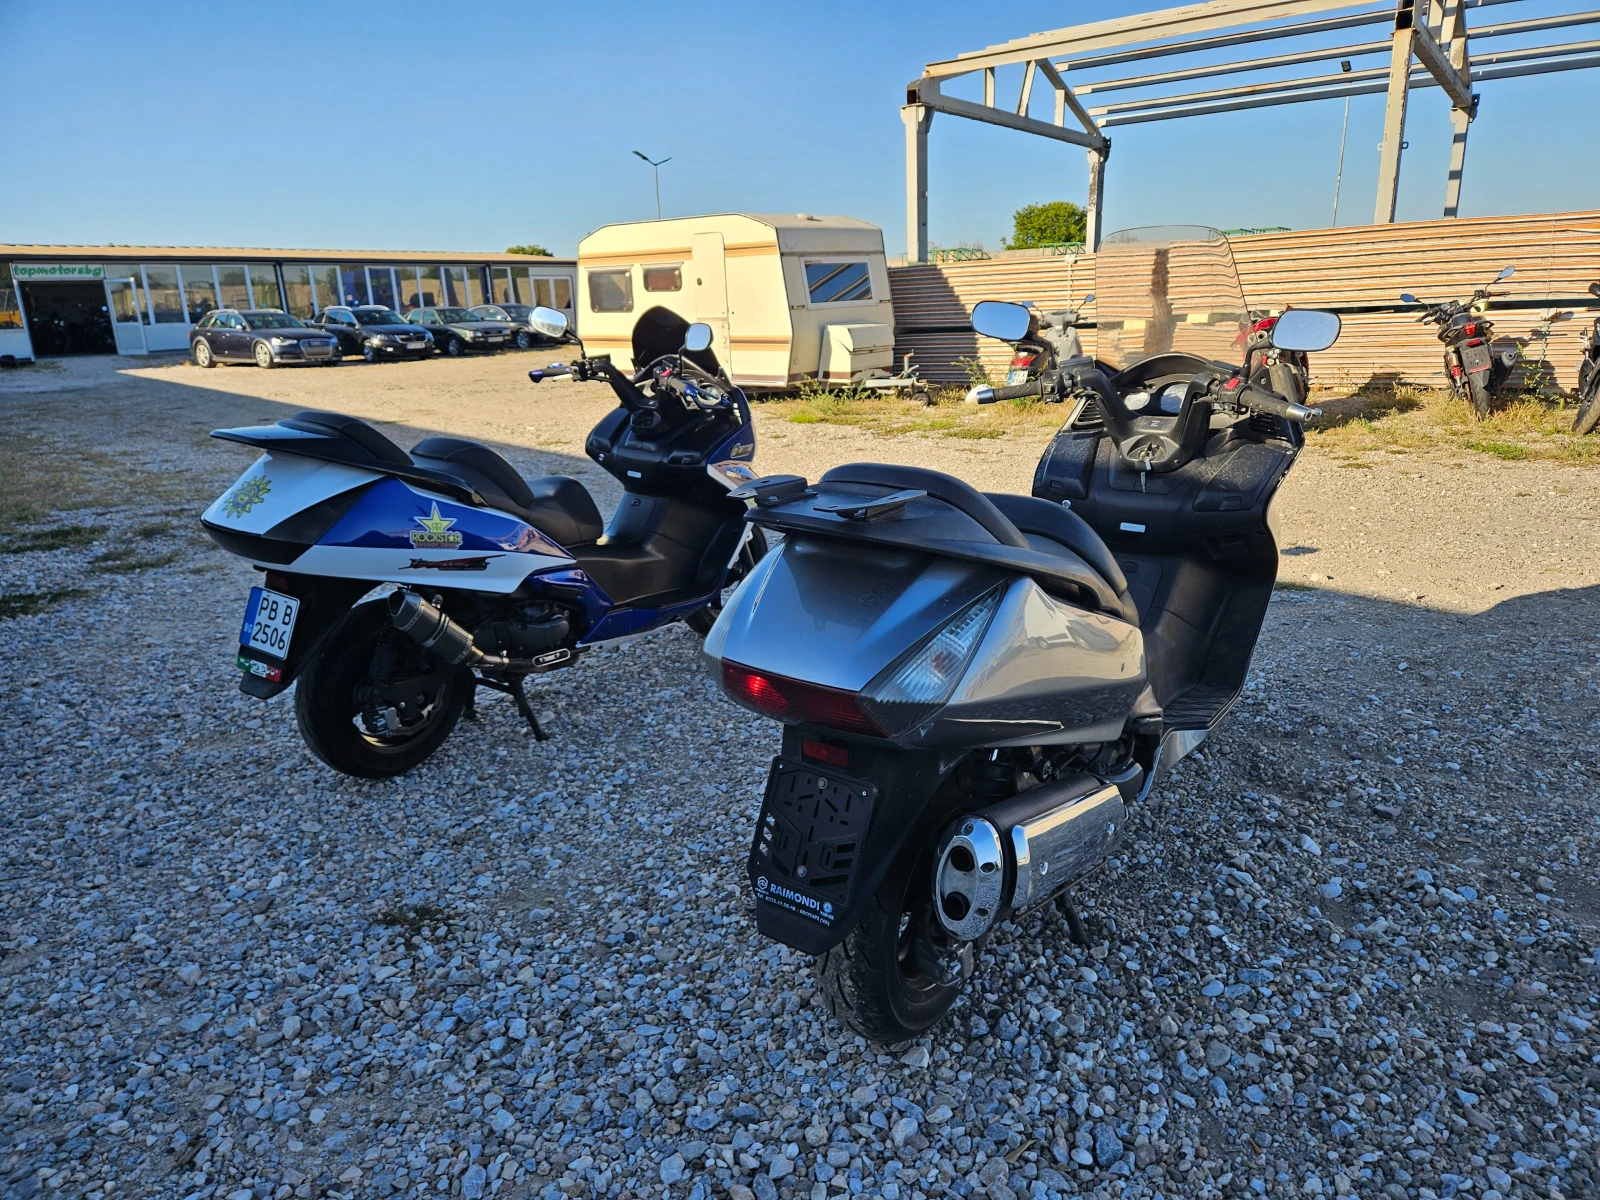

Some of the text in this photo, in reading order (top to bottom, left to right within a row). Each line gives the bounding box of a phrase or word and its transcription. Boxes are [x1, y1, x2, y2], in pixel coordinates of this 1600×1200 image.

[13, 264, 102, 278] topmotorsbg
[258, 597, 293, 626] PB B
[243, 622, 253, 633] BG
[252, 622, 287, 650] 2506
[770, 883, 820, 911] RAIMONDI
